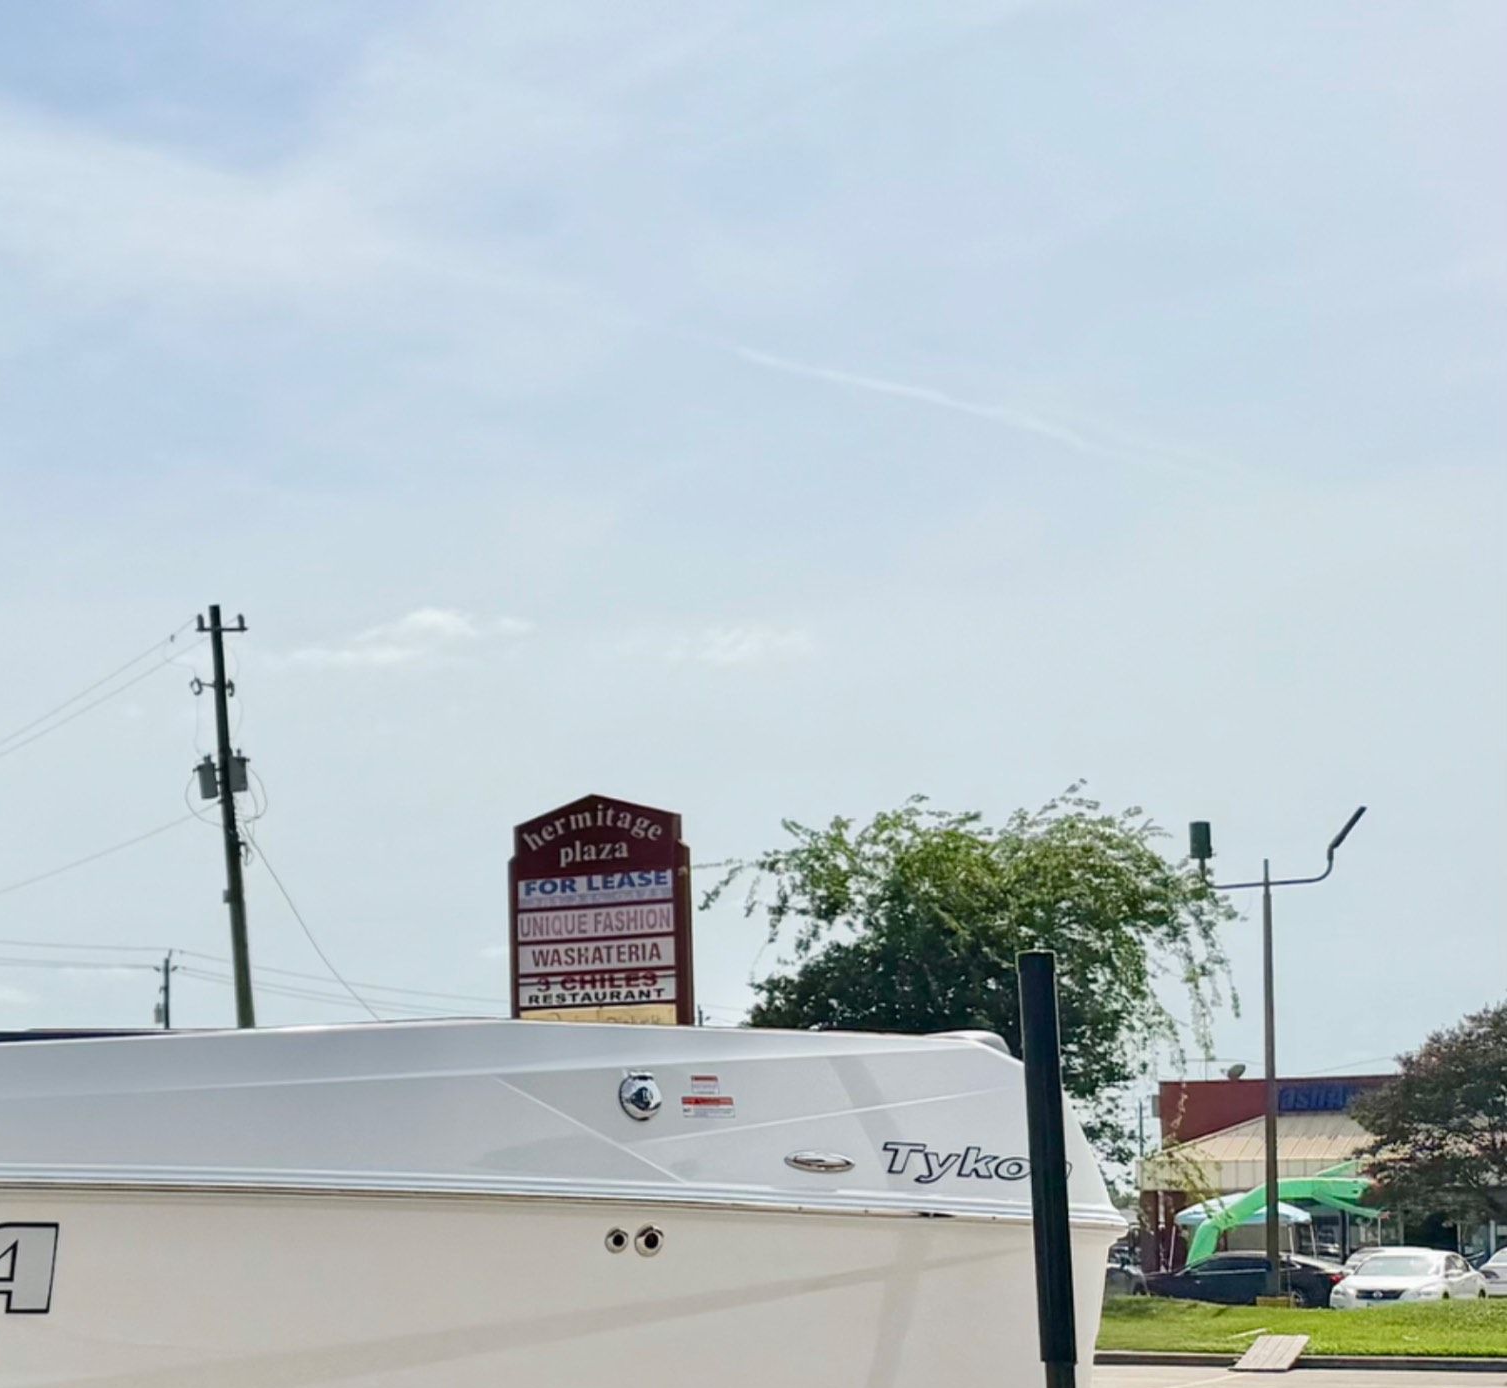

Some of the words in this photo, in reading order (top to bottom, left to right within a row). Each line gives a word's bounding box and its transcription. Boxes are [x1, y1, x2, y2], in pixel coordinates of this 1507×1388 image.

[522, 804, 663, 851] hermitage
[559, 840, 629, 868] plaza
[524, 877, 577, 896] FOR
[587, 869, 669, 891] LEASE
[520, 913, 587, 938] UNIQUE
[594, 906, 671, 933] FASHION
[532, 942, 662, 968] WASHATERIA
[528, 988, 666, 1005] RESTAURANT
[882, 1141, 1073, 1184] Tyko
